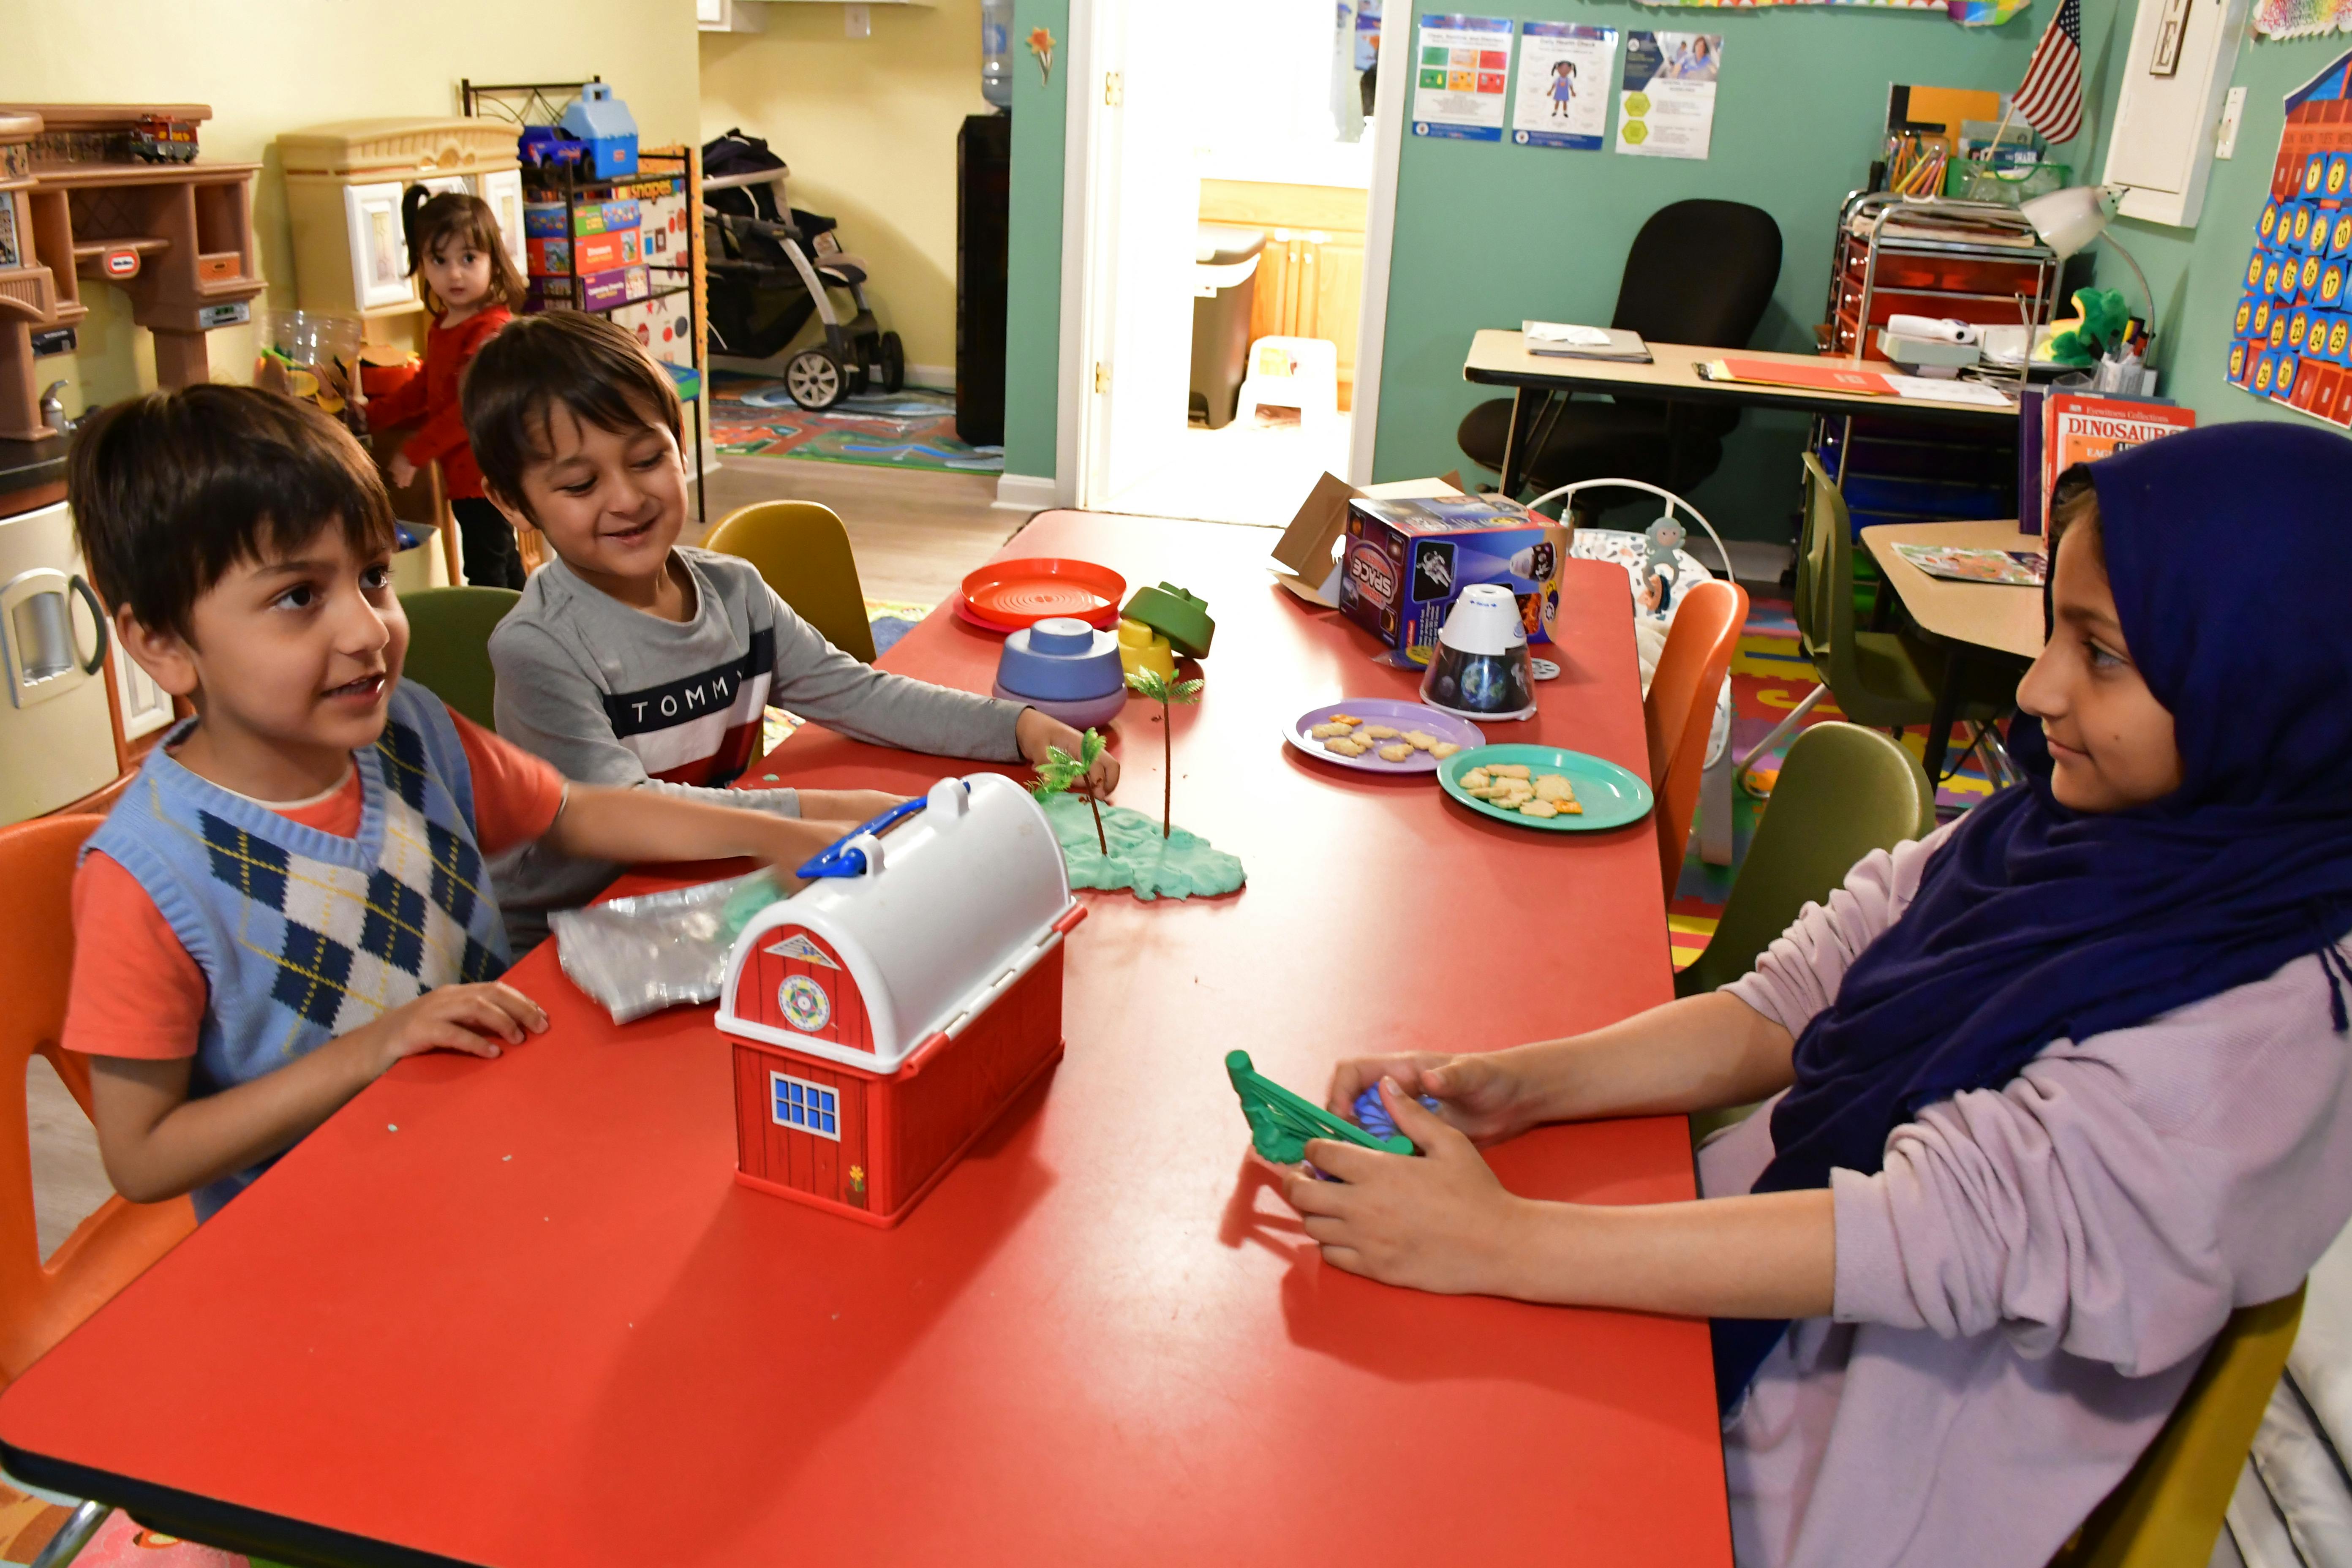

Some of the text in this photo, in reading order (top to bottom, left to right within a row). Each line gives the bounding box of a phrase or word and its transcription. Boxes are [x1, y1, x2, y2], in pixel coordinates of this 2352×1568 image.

[2331, 172, 2339, 188] 2
[2314, 228, 2322, 244] 9
[2337, 227, 2348, 245] 10
[2284, 270, 2294, 286] 15
[2305, 265, 2314, 284] 16
[2326, 278, 2336, 295] 17
[2311, 330, 2323, 347] 24
[2331, 331, 2344, 349] 25
[2086, 406, 2126, 418] Eyewitness
[2127, 411, 2170, 423] Collections
[1352, 556, 1392, 599] SPACE
